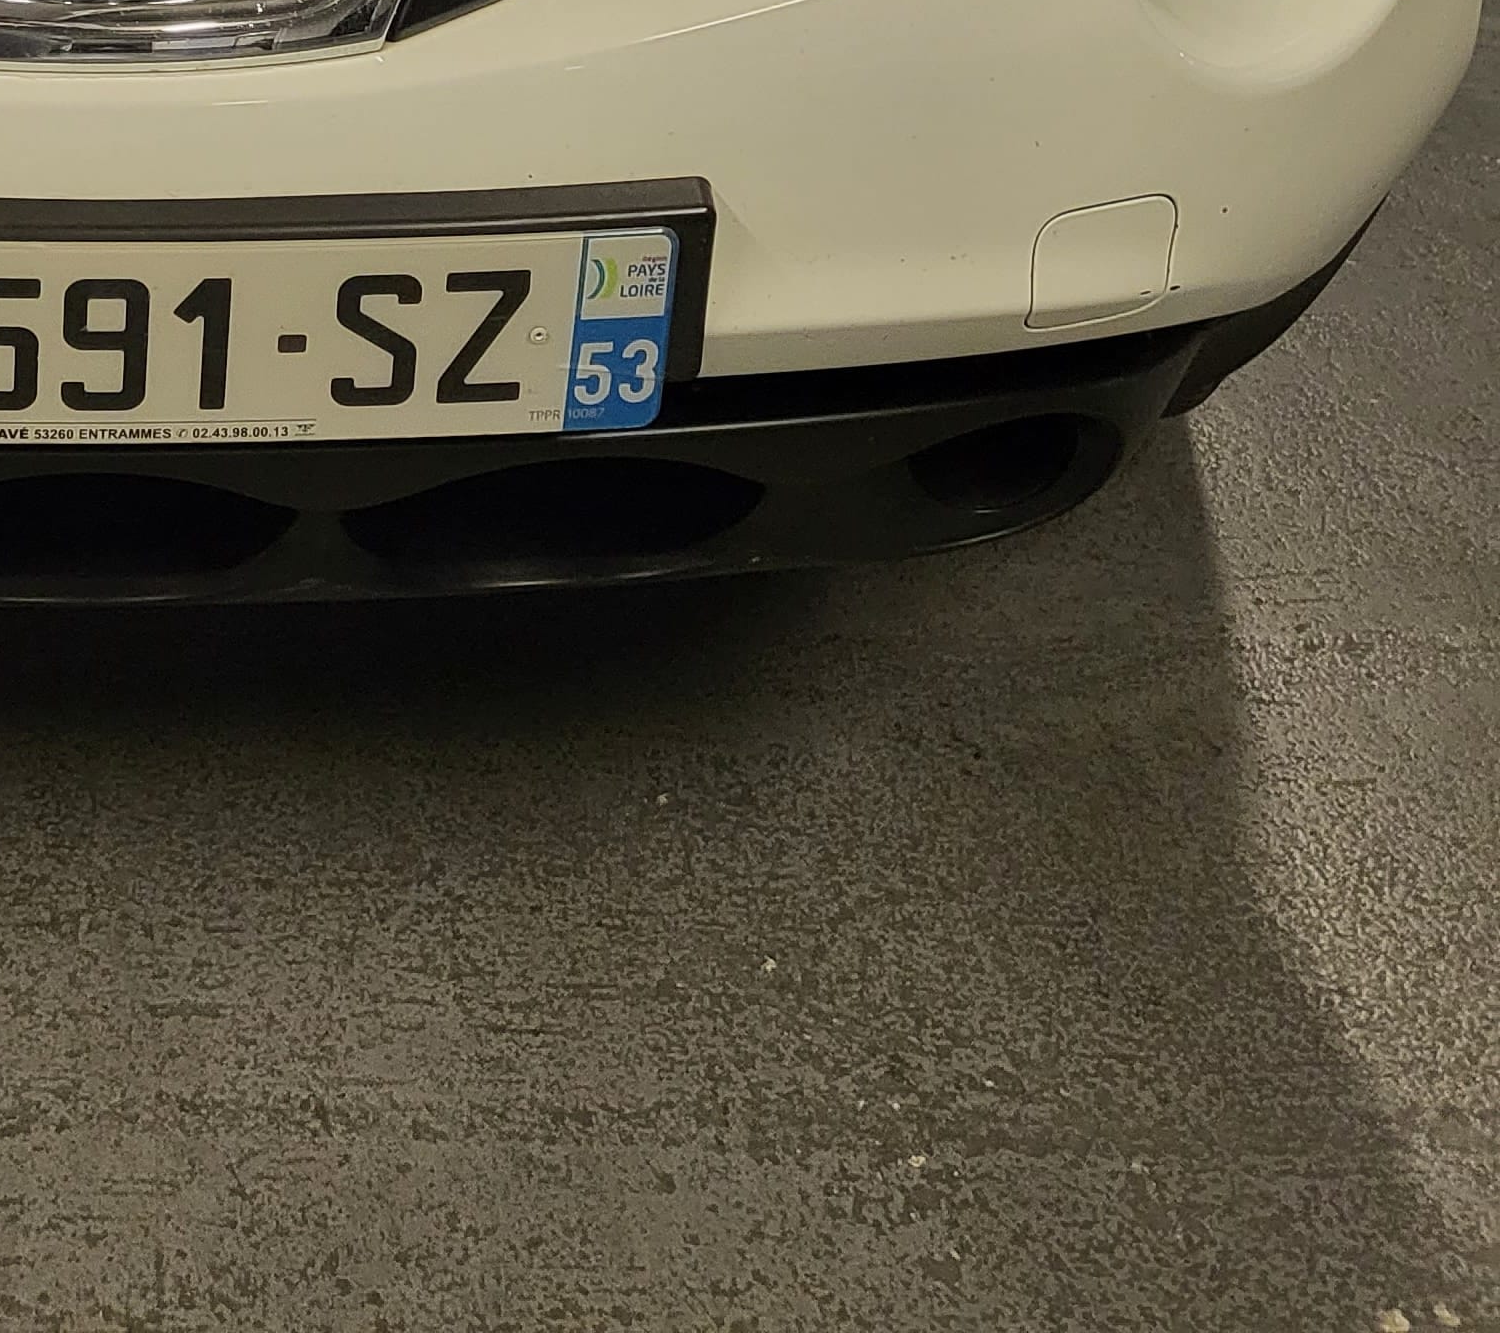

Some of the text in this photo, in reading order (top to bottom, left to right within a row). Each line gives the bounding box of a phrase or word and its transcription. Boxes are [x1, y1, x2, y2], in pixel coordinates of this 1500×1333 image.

[627, 263, 667, 278] PAYS
[619, 283, 666, 298] LOIRE
[573, 338, 659, 405] 53
[33, 427, 75, 440] 53260
[78, 426, 172, 440] ENTRAMMES
[192, 425, 290, 439] 02.43.98.00.13
